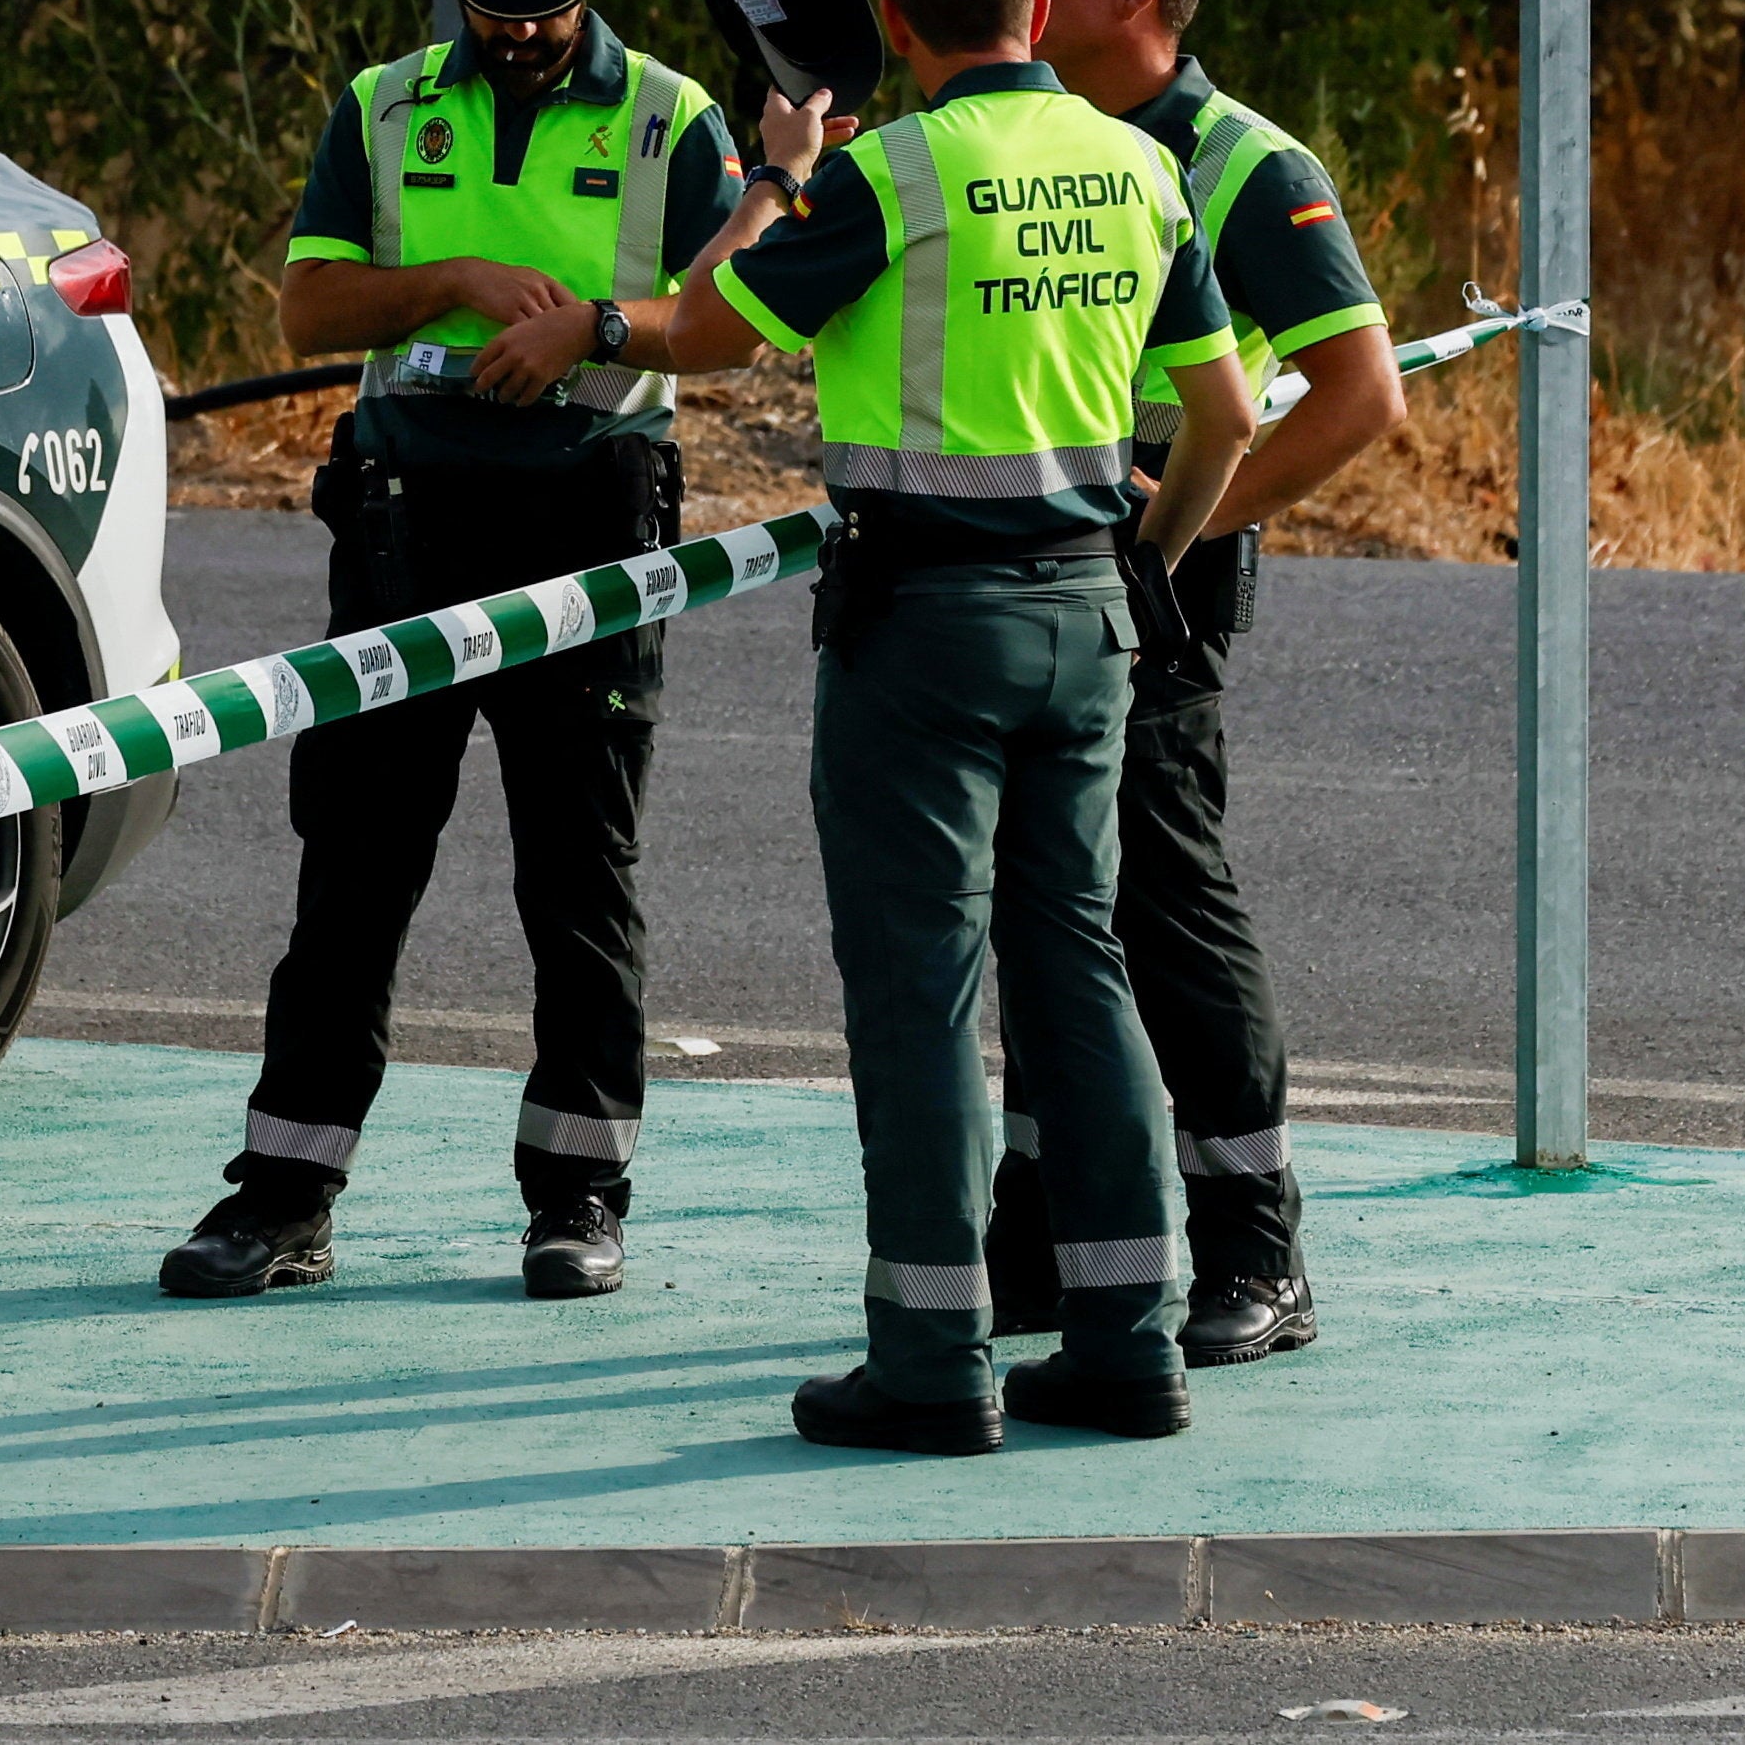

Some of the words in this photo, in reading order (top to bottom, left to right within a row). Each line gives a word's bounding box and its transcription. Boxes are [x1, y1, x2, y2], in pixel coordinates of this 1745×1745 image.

[965, 171, 1145, 215] GUARDIA
[1017, 219, 1105, 257] CIVIL
[974, 267, 1139, 314] TRÁFICO
[43, 427, 107, 495] 062
[645, 564, 676, 597] GUARDIA
[358, 643, 392, 676] GUARDIA
[462, 630, 494, 663] TRAFICO
[370, 673, 393, 701] CIVIL
[66, 721, 103, 753] GUARDIA
[173, 709, 206, 741] TRAFICO
[88, 751, 107, 780] CIVIL
